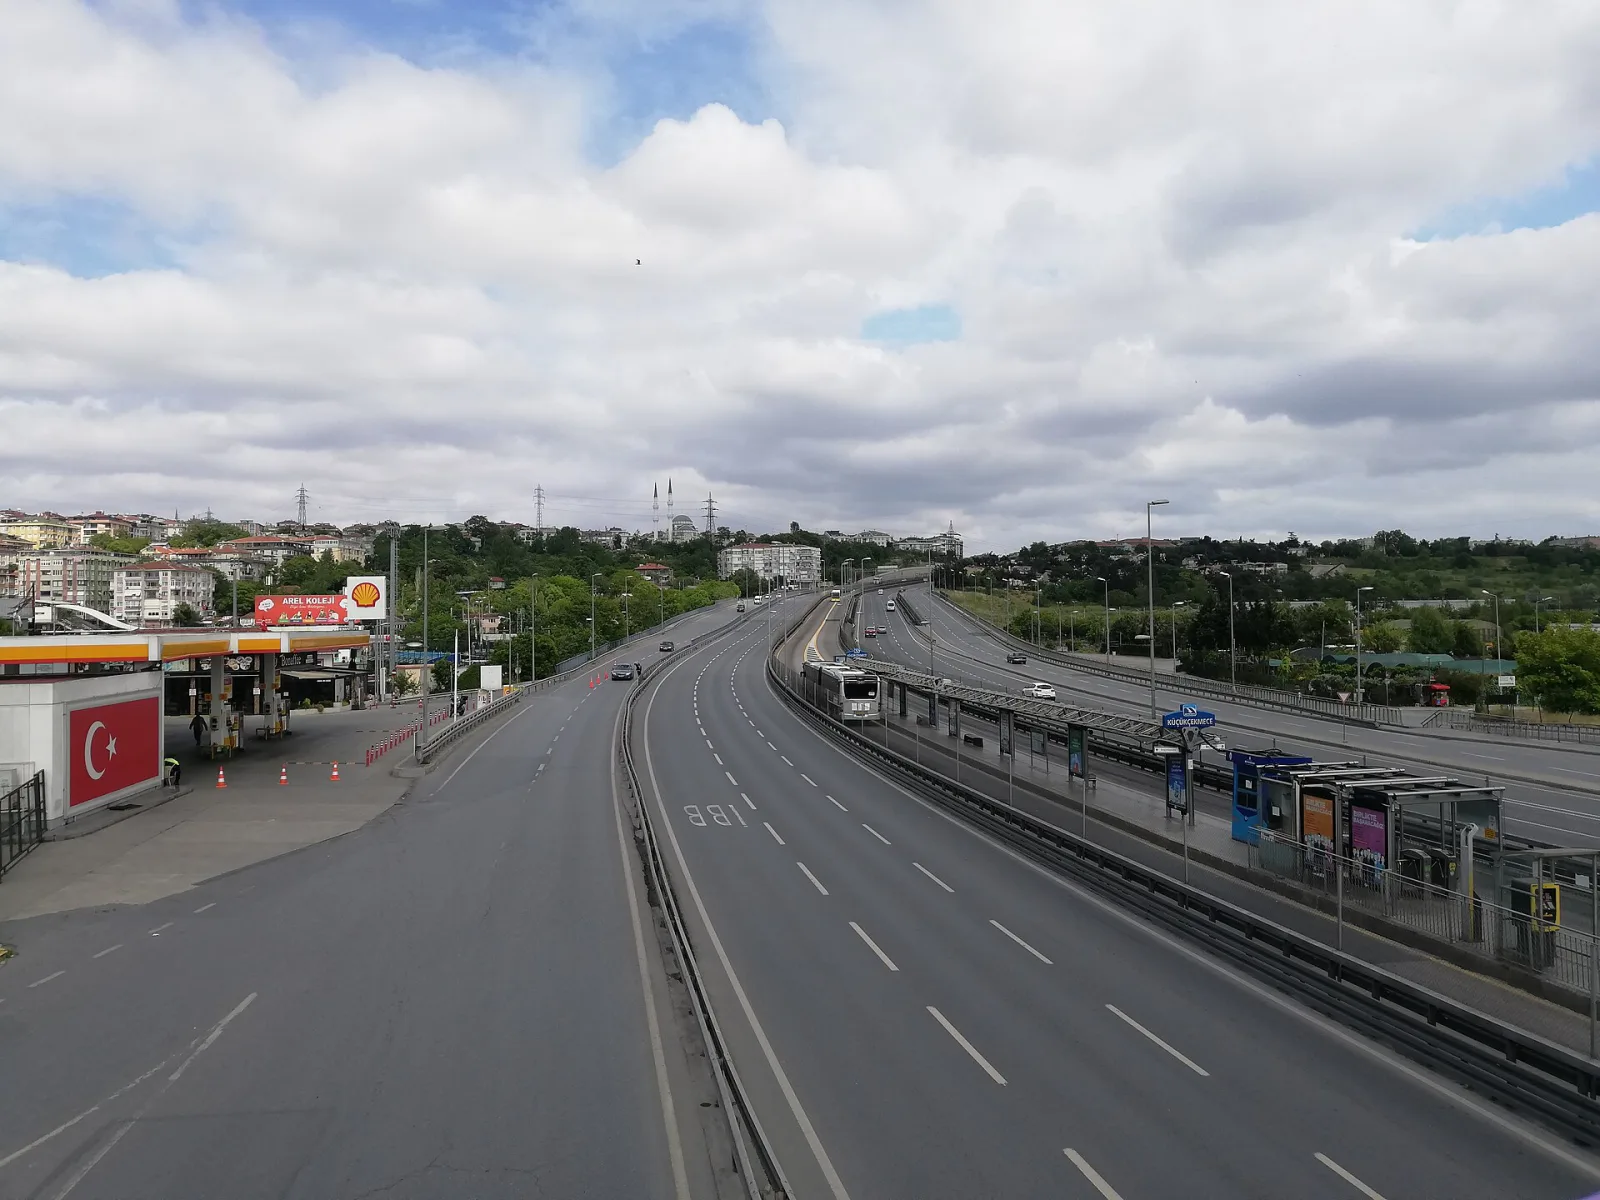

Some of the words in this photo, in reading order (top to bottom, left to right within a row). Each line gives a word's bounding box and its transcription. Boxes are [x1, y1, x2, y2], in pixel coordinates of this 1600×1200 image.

[282, 597, 303, 605] AREL
[306, 596, 335, 605] KOLEJİ
[1167, 717, 1213, 727] KÜÇÜKÇEKMECE
